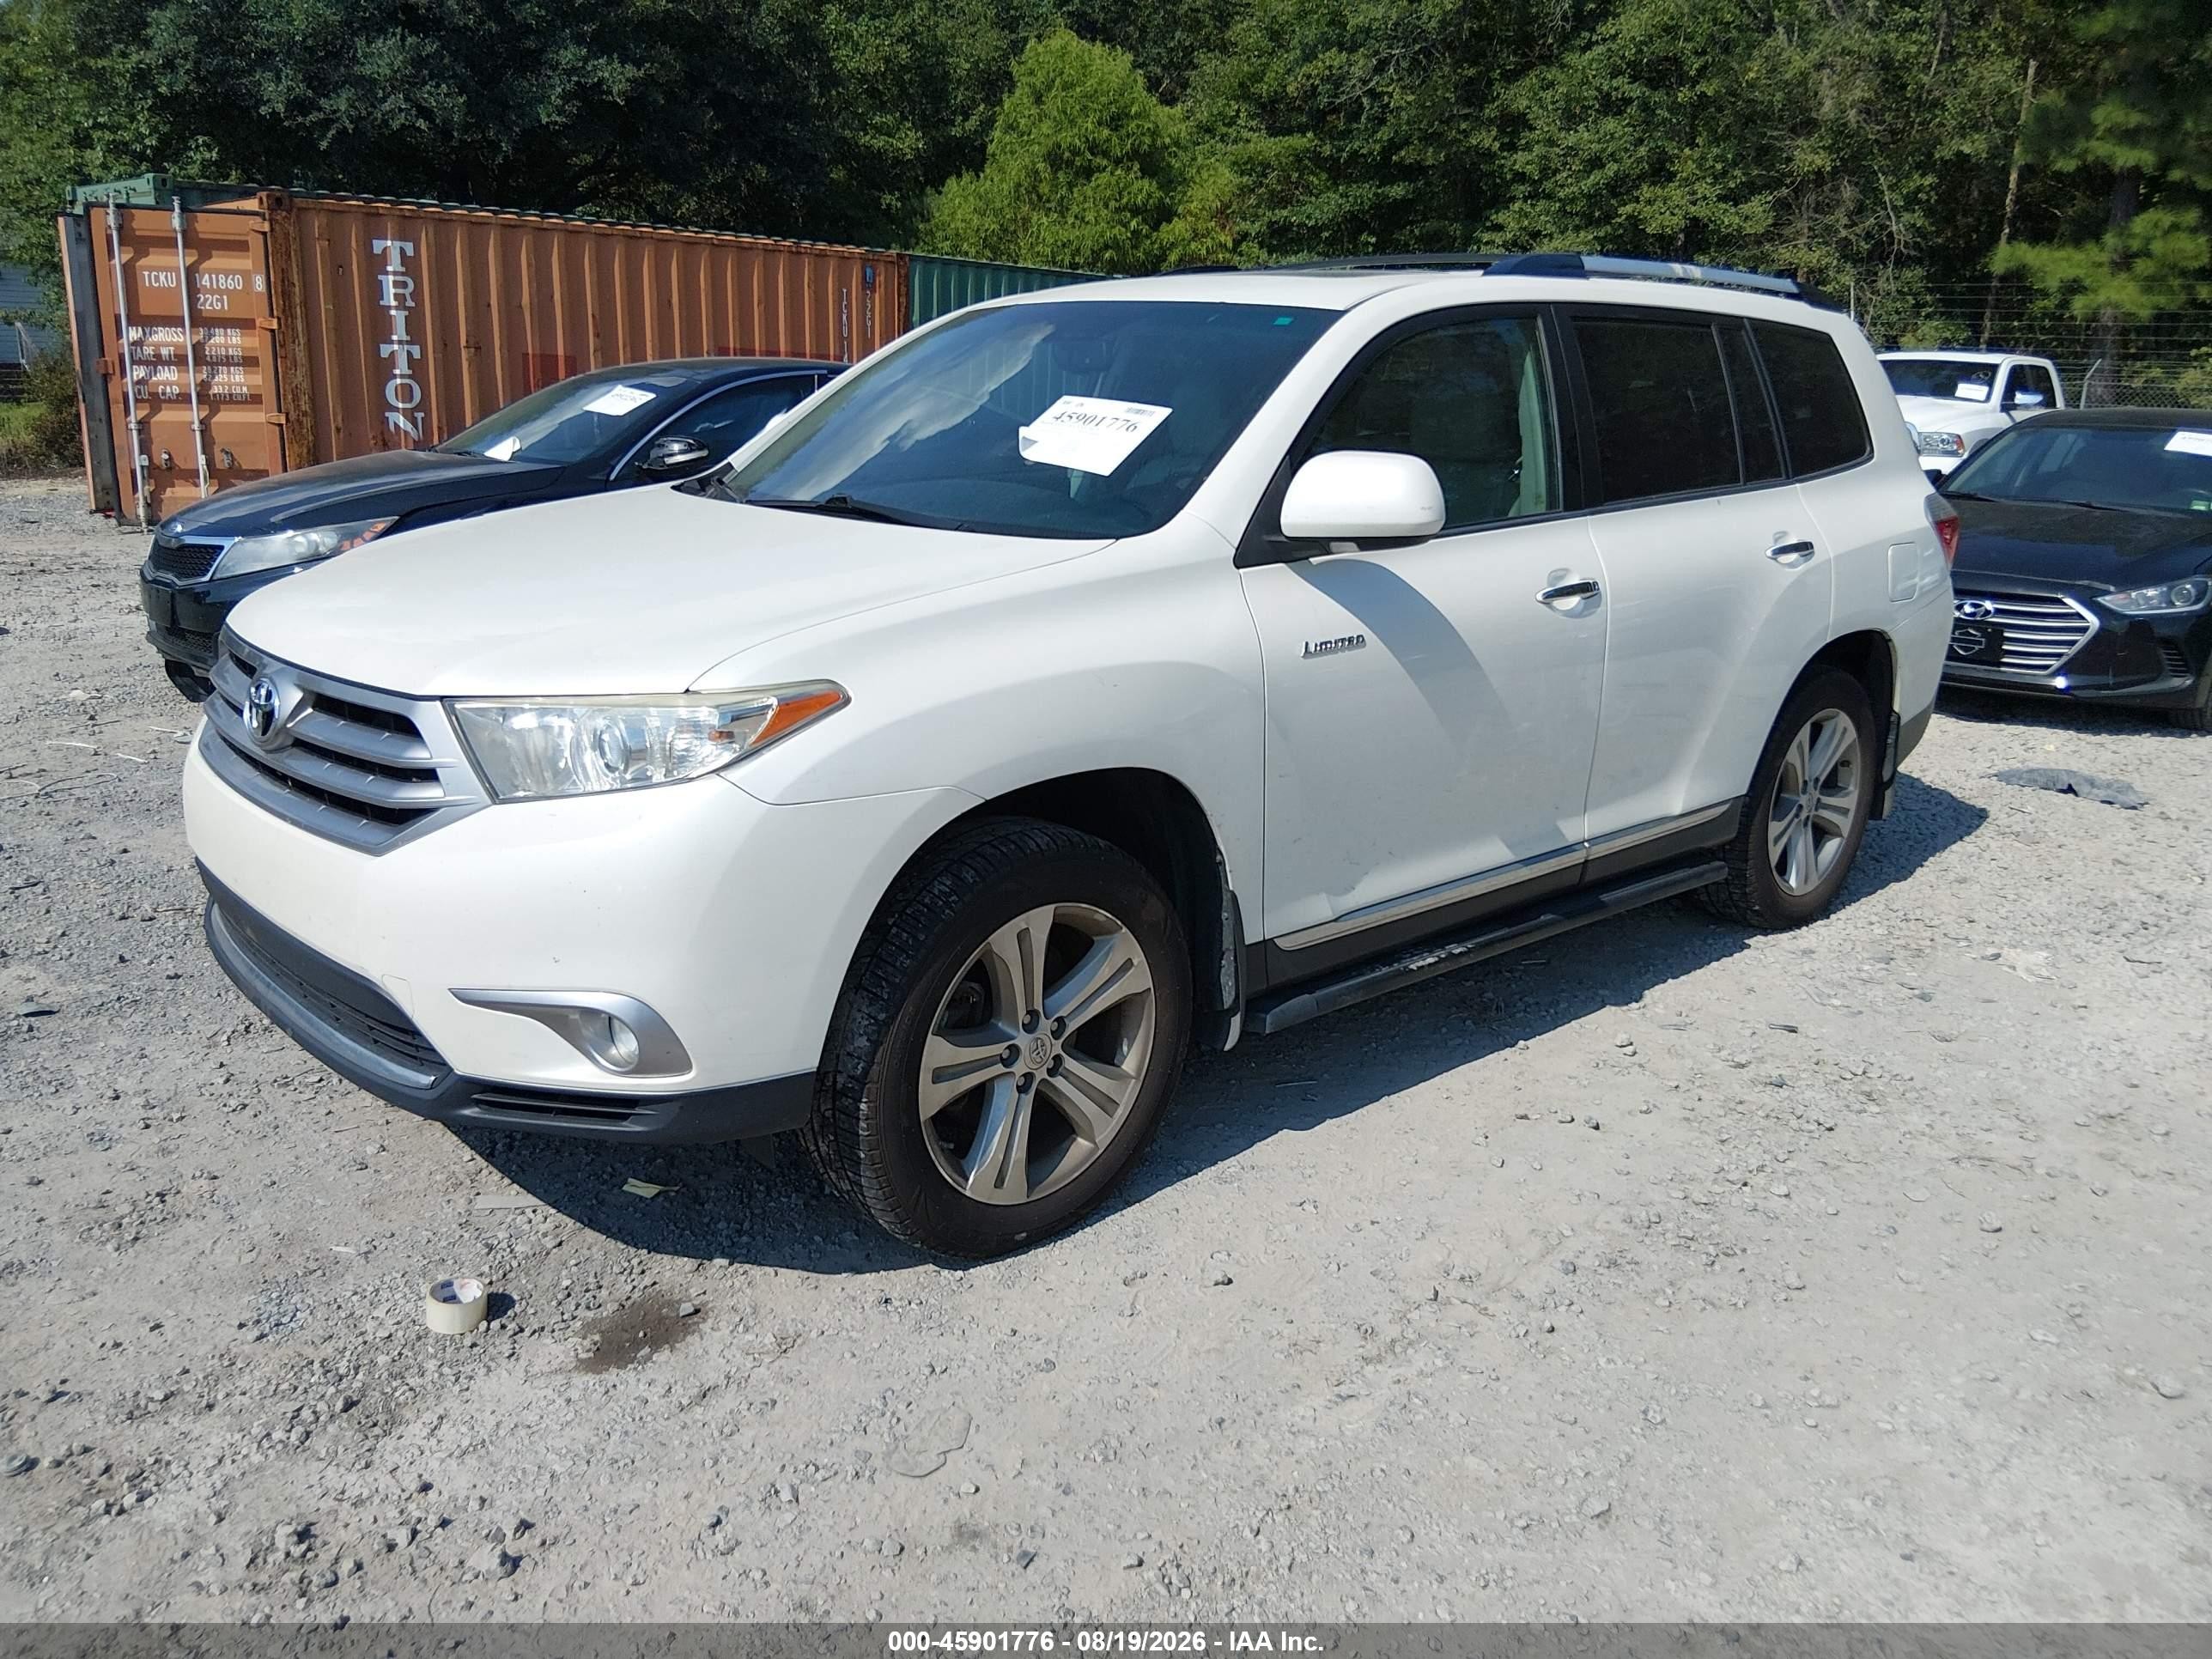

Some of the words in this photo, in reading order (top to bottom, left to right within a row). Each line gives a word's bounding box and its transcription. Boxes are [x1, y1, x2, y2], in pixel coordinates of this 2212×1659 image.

[143, 271, 177, 288] TCKU
[195, 273, 243, 290] 141860
[255, 275, 264, 291] 8
[197, 294, 228, 310] 22G1
[228, 336, 241, 344] LBS
[372, 239, 425, 441] TRITON
[131, 346, 157, 362] TARE
[133, 365, 178, 381] PAYLOAD
[1053, 410, 1141, 433] 45901776
